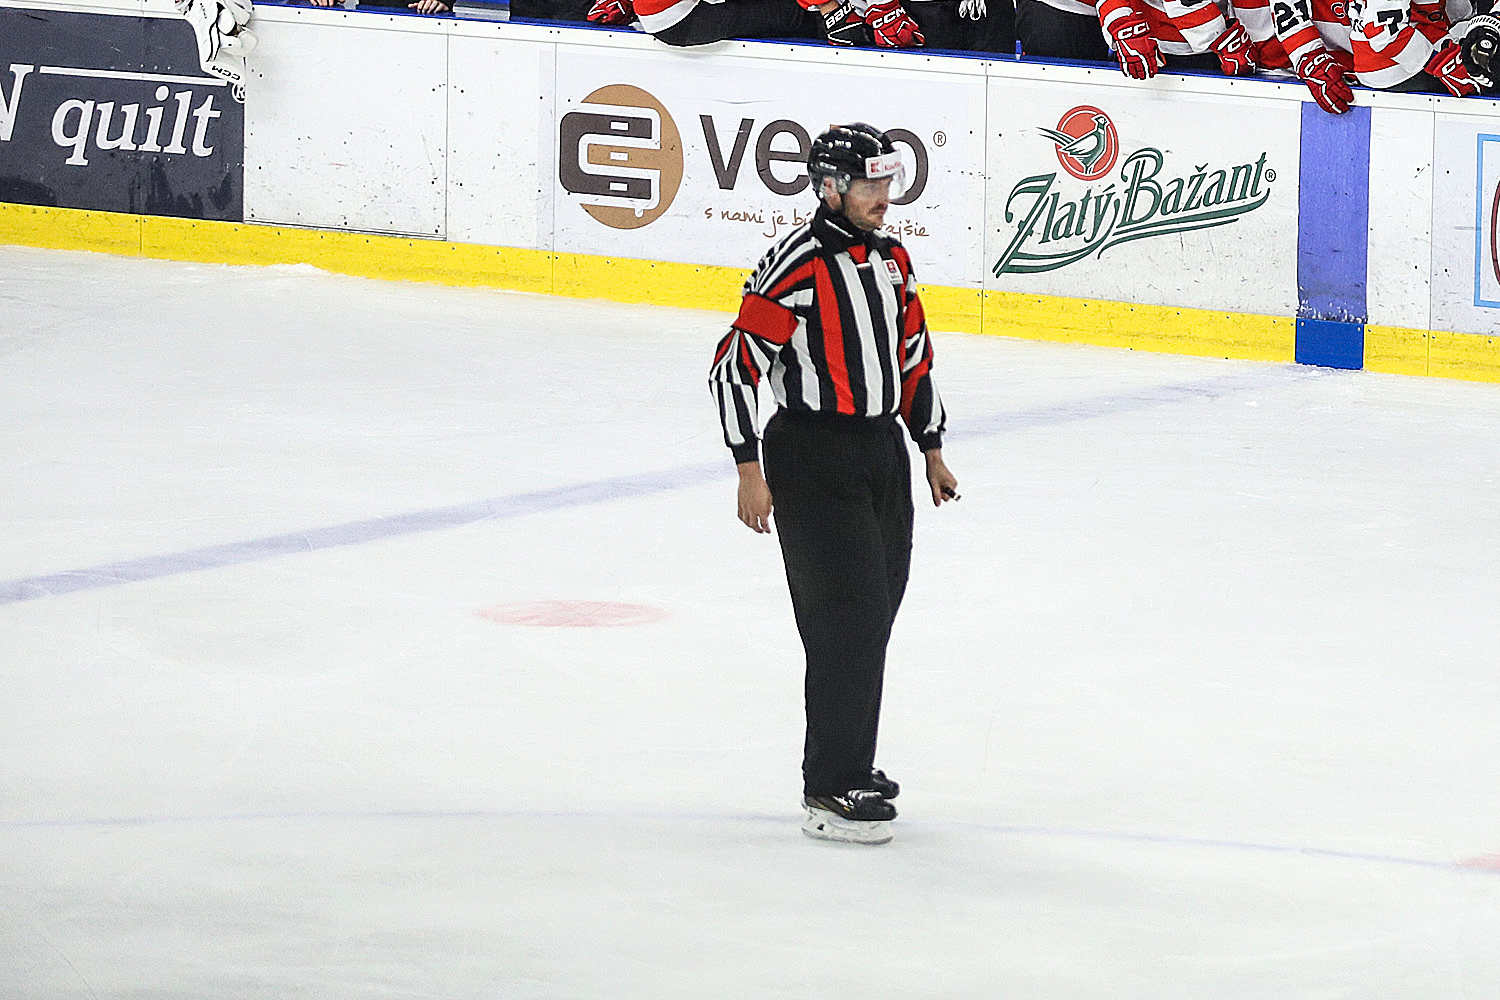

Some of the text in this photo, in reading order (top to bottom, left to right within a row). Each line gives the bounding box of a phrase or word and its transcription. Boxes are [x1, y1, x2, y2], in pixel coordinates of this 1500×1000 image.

[1273, 0, 1310, 36] 21
[51, 85, 222, 166] quilt
[699, 113, 929, 206] veo
[704, 207, 714, 219] s
[721, 209, 765, 224] nami
[763, 210, 789, 238] je
[878, 219, 931, 243] rajšie
[992, 147, 1269, 279] Zlatý Bažant
